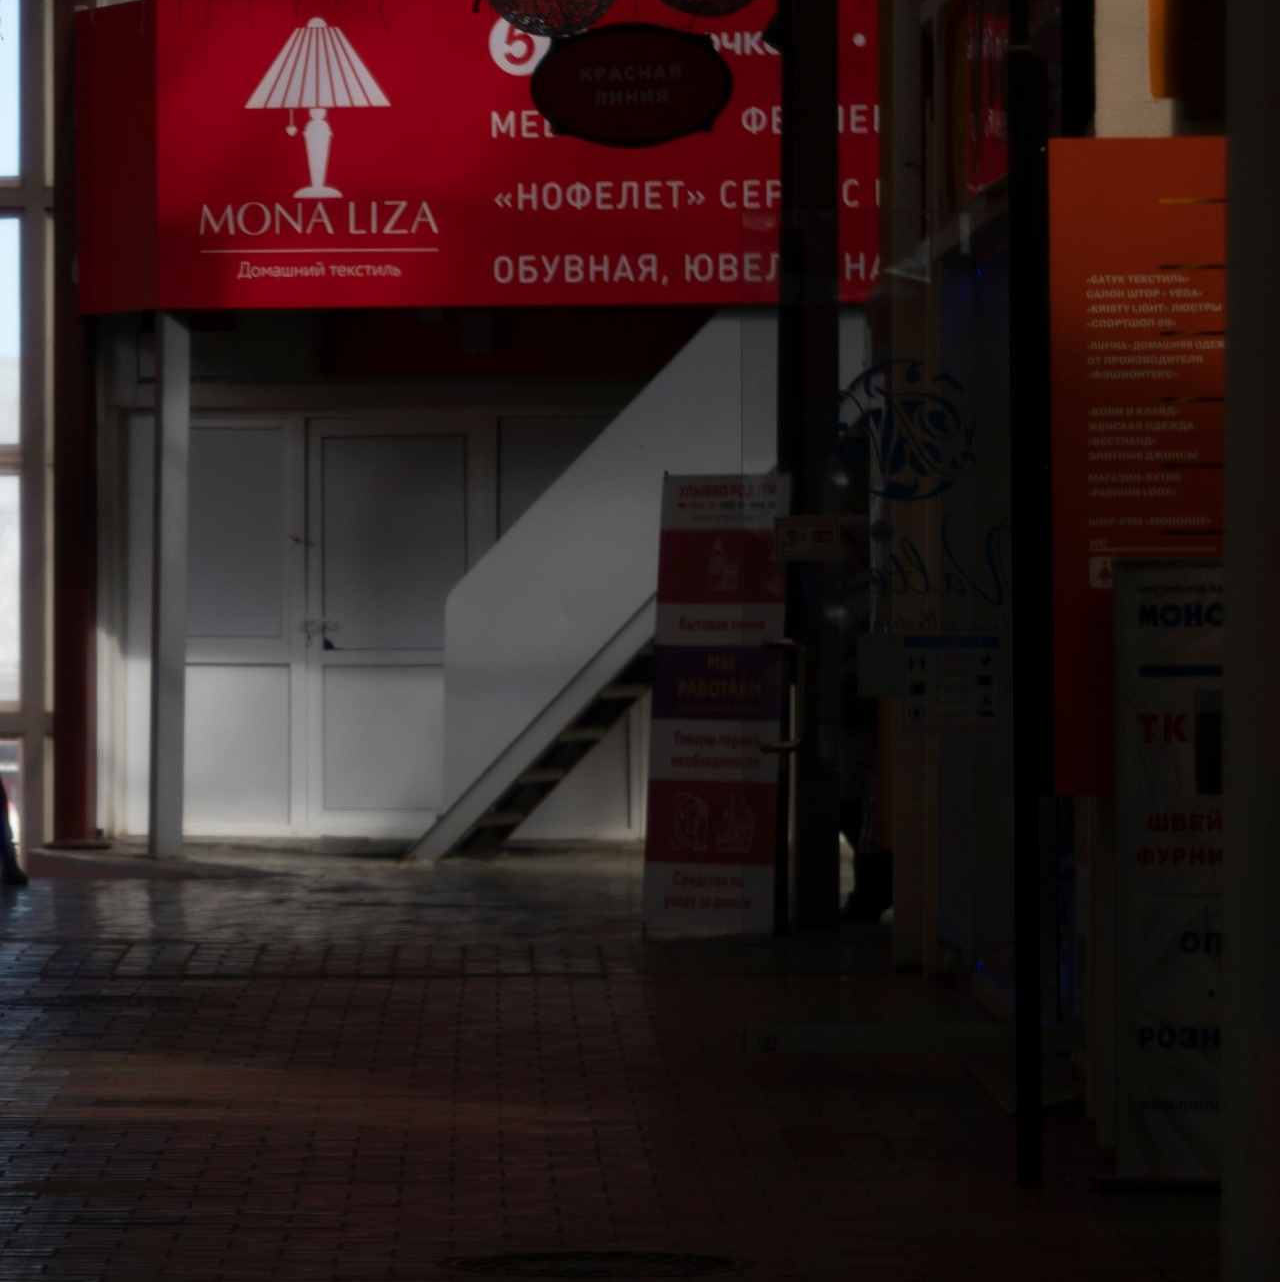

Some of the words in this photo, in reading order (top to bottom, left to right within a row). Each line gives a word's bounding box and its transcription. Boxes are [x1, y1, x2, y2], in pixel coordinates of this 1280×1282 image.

[578, 63, 683, 84] КРАСНАЯ
[593, 87, 670, 106] ЛИНИЯ
[493, 179, 706, 212] «НОФЕЛЕТ»
[198, 199, 336, 236] MONA
[347, 199, 441, 236] LIZA
[235, 259, 326, 281] Домашний
[329, 263, 403, 279] текстиль
[492, 252, 670, 287] ОБУВНАЯ,
[1085, 288, 1125, 299] САЛОН
[1126, 288, 1160, 299] ШТОР
[1170, 302, 1223, 313] ЛЮСТРЫ
[706, 652, 735, 672] МЫ
[677, 678, 763, 699] РАБОТАЕМ
[1138, 1025, 1221, 1050] РОЗН
